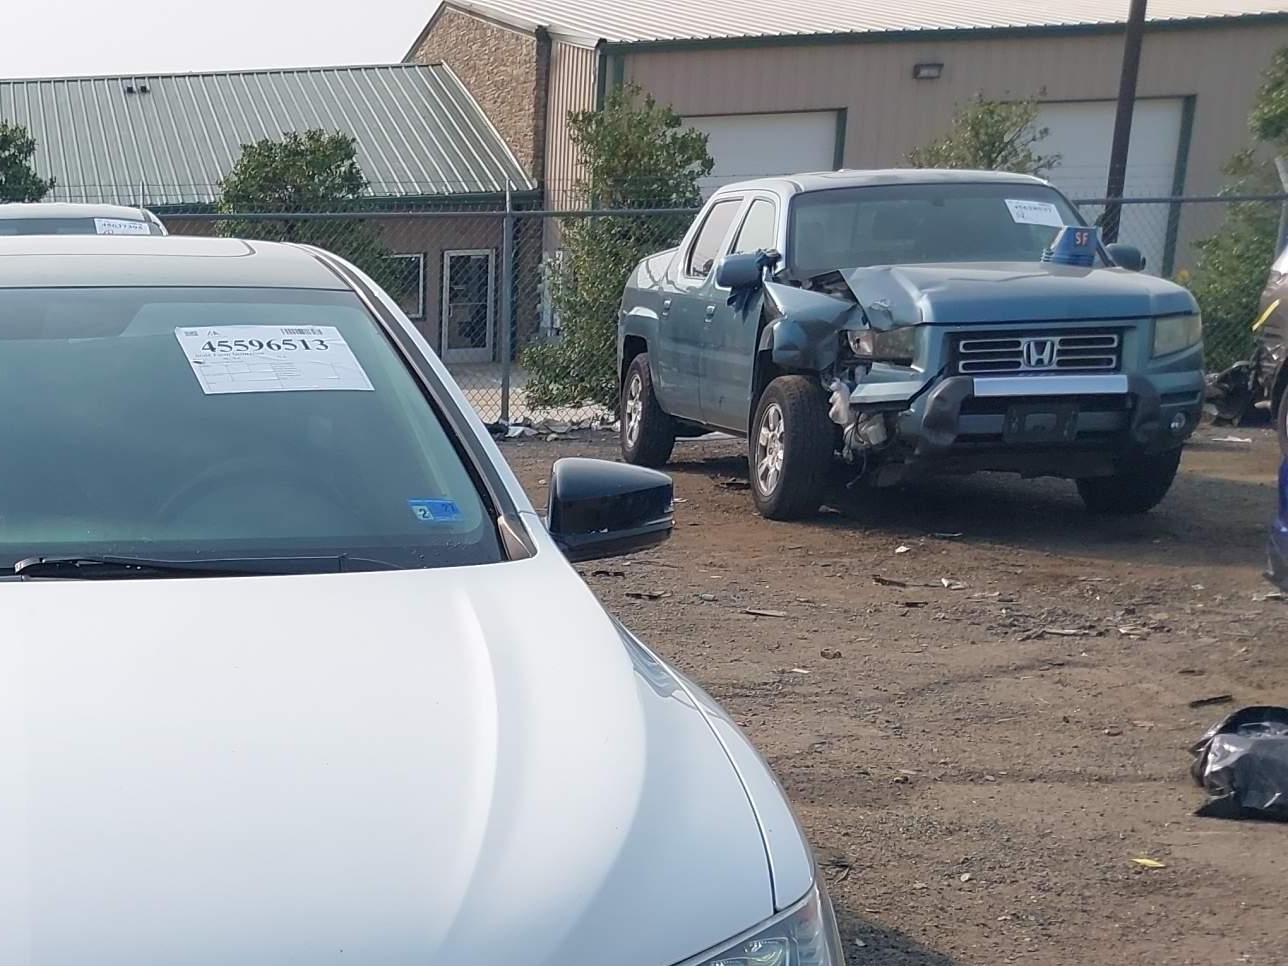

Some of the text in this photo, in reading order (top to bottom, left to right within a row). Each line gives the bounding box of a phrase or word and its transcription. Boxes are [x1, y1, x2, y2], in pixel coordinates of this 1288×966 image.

[1075, 231, 1089, 246] SF
[201, 339, 329, 353] 45596513
[418, 508, 430, 519] 2
